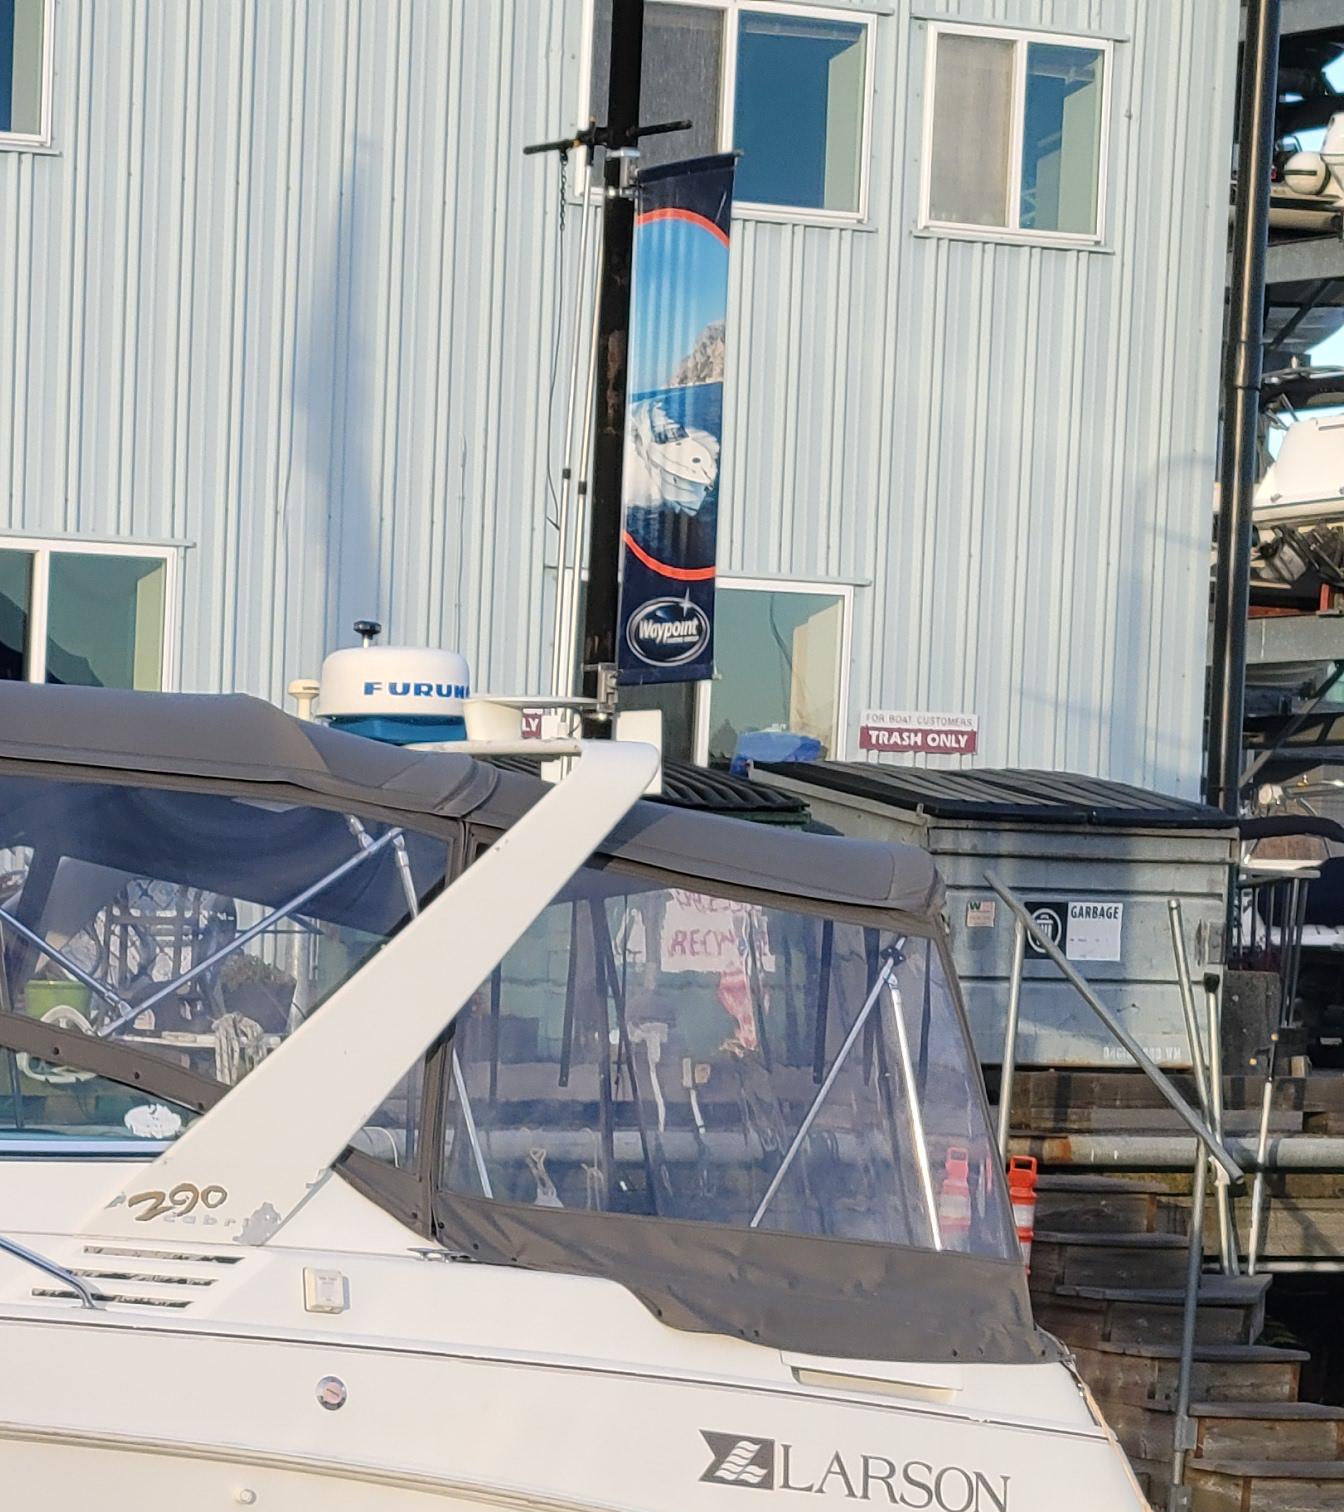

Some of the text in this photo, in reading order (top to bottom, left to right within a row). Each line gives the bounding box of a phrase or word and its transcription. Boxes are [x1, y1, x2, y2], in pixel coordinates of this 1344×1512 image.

[639, 617, 699, 644] Waypoint
[364, 682, 470, 699] FURUN
[522, 716, 539, 732] LY
[869, 730, 968, 748] TRASH ONLY
[1071, 905, 1120, 920] GARBAGE
[128, 1182, 228, 1222] 290
